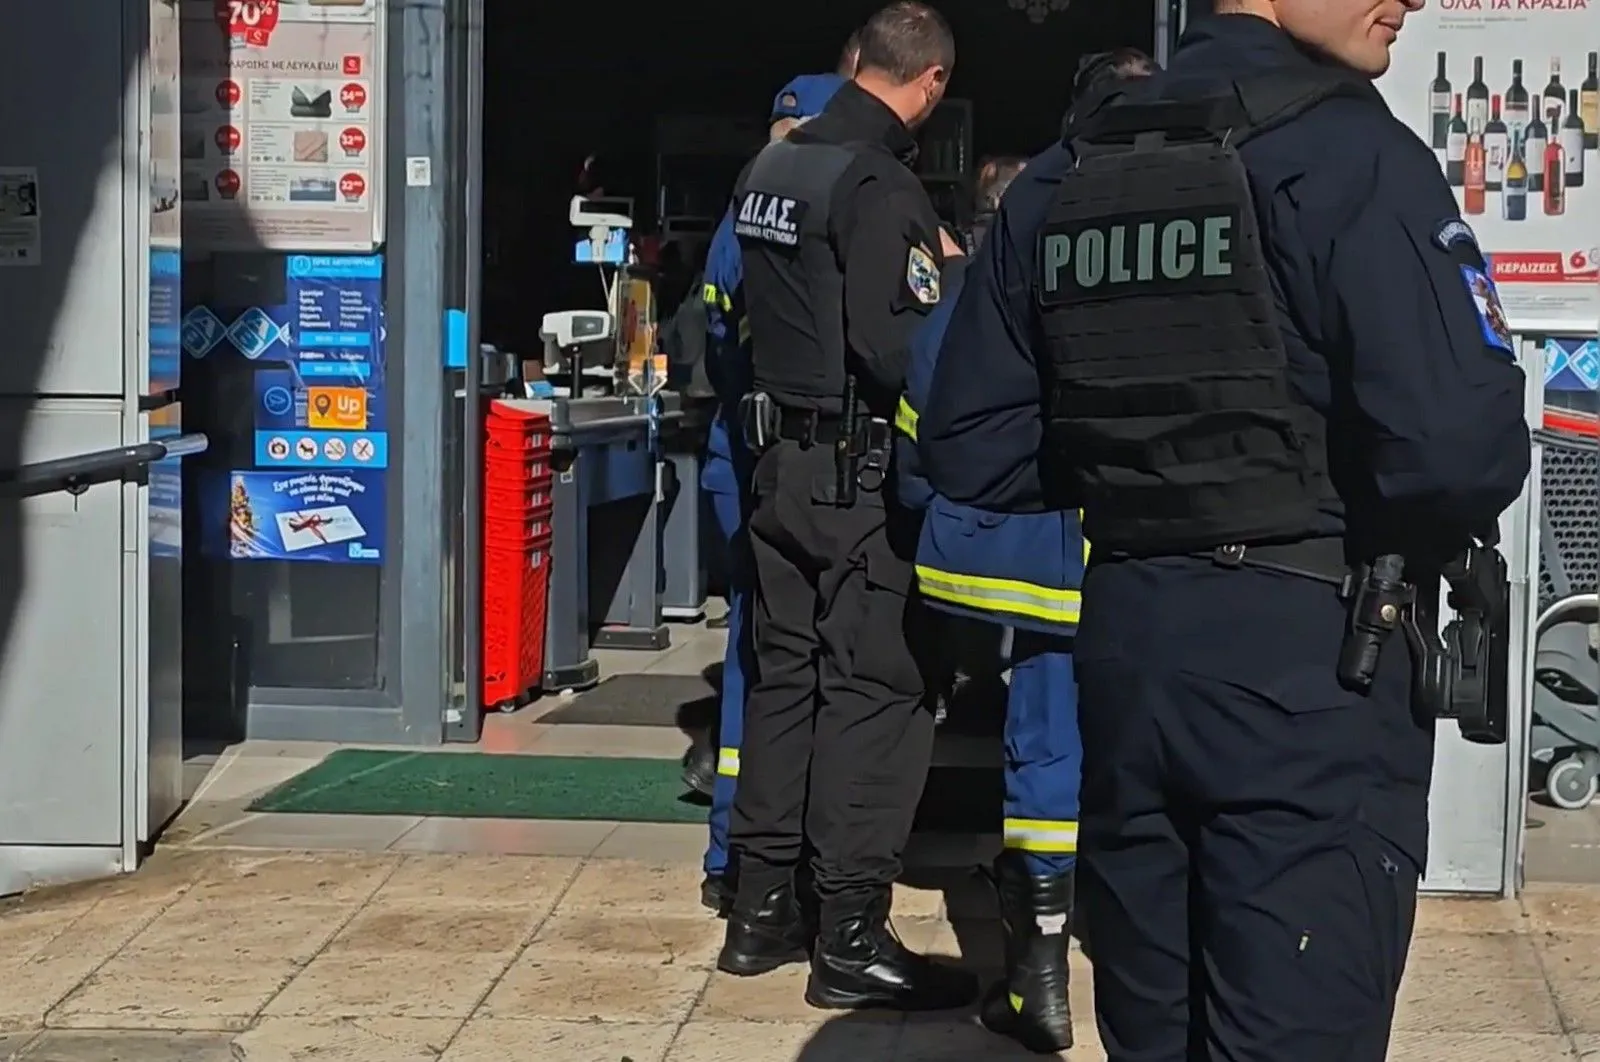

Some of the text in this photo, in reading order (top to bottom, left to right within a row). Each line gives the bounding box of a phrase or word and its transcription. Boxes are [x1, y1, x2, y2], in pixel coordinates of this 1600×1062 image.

[738, 192, 797, 232] ΔΙ.ΑΣ.
[1044, 215, 1233, 292] POLICE
[337, 394, 361, 414] Up
